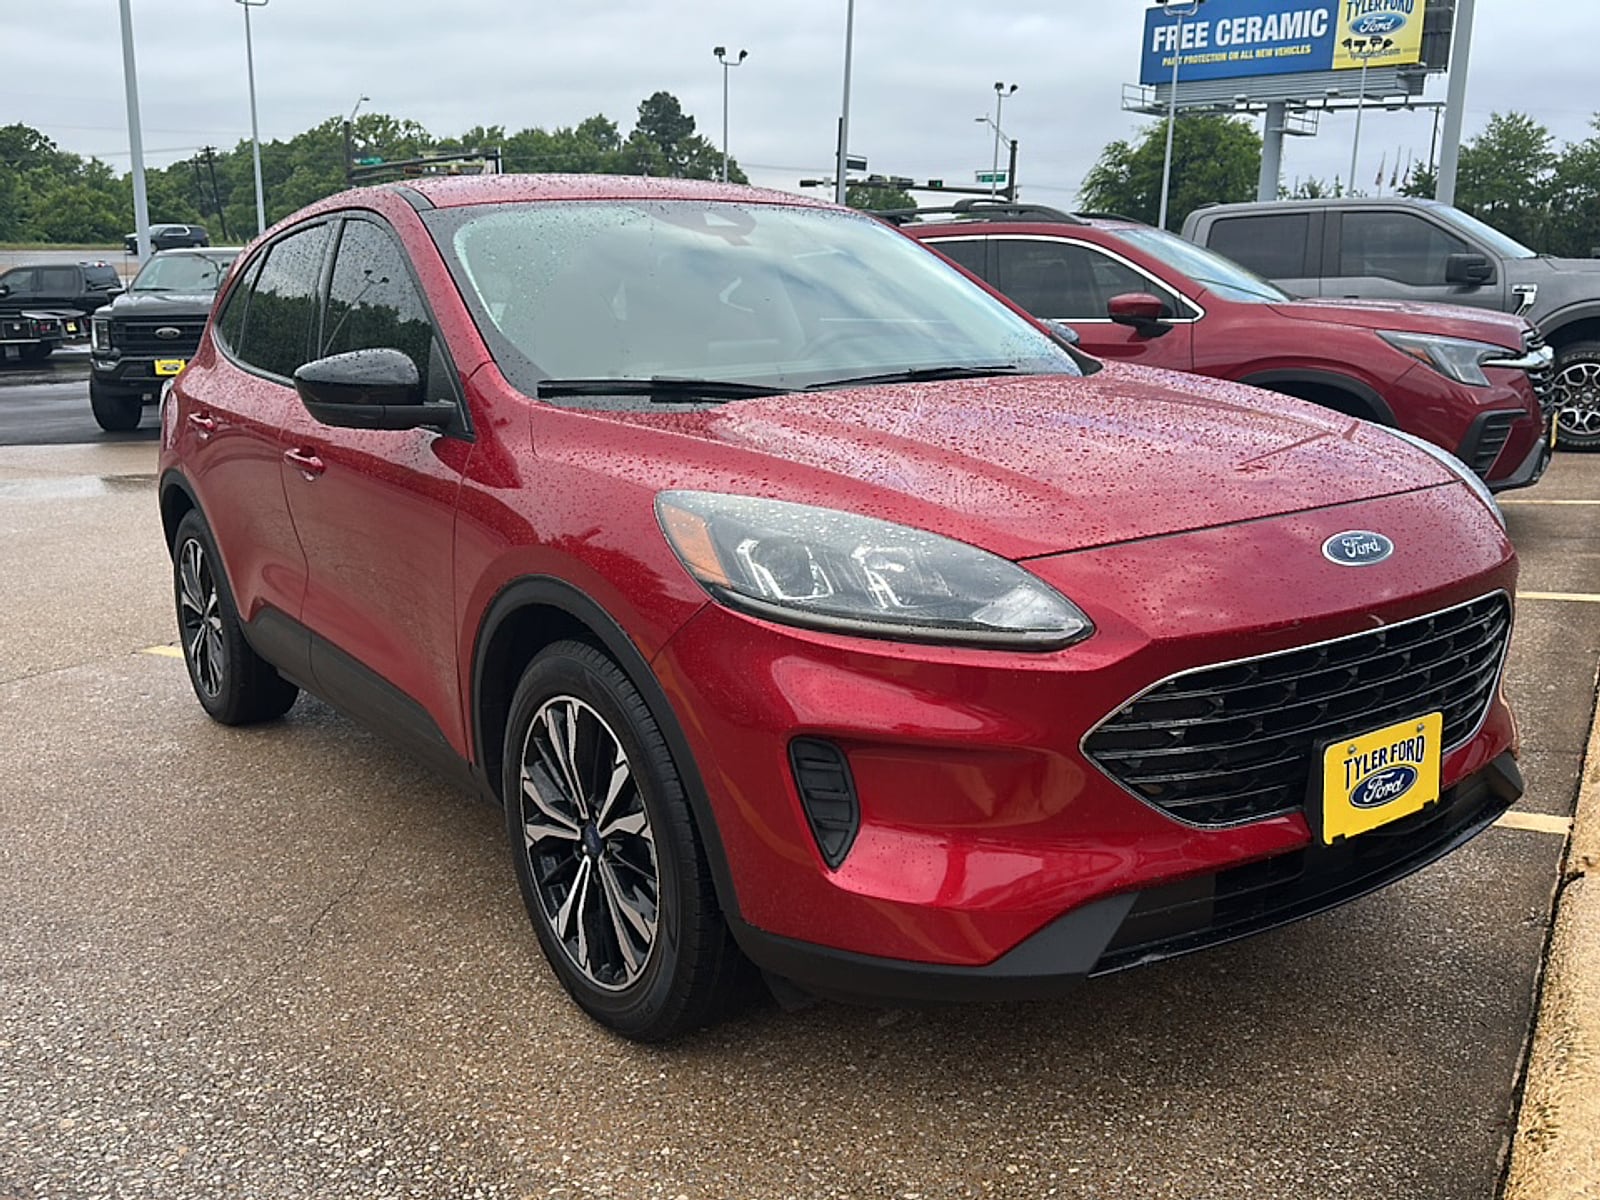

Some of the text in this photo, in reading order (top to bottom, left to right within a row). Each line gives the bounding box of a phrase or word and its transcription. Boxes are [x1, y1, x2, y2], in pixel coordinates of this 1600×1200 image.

[1347, 0, 1414, 21] TYLER FORD
[1152, 8, 1328, 52] FREE CERAMIC
[1359, 16, 1394, 33] Ford
[1162, 56, 1182, 67] PAIT
[1240, 49, 1254, 60] ALL
[1275, 44, 1311, 57] VEHICLES
[1341, 535, 1381, 558] Ford
[1344, 734, 1424, 791] TYLER FORD
[1363, 771, 1405, 803] Ford
